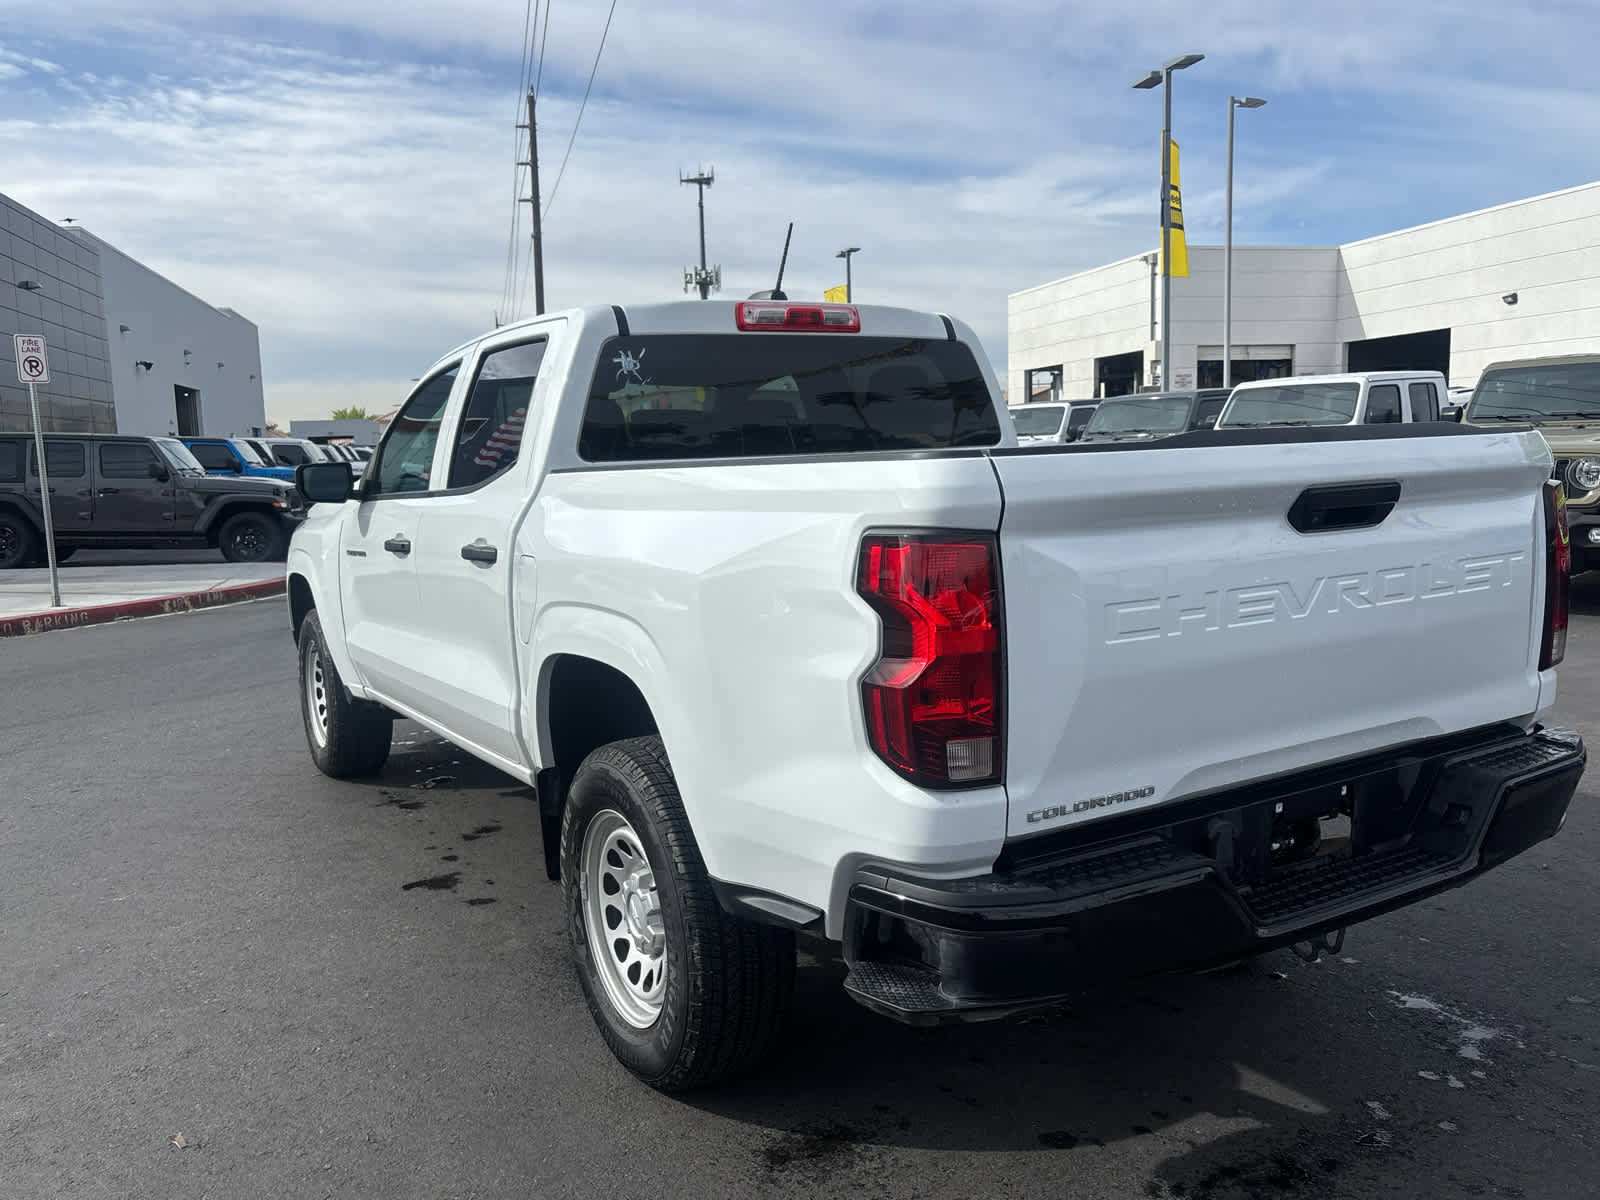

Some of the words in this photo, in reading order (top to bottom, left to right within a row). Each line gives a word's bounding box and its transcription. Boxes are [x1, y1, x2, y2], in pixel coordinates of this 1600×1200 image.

[1104, 550, 1525, 645] CHEVROLET
[22, 611, 89, 634] PARKING
[1026, 785, 1155, 823] COLORADO
